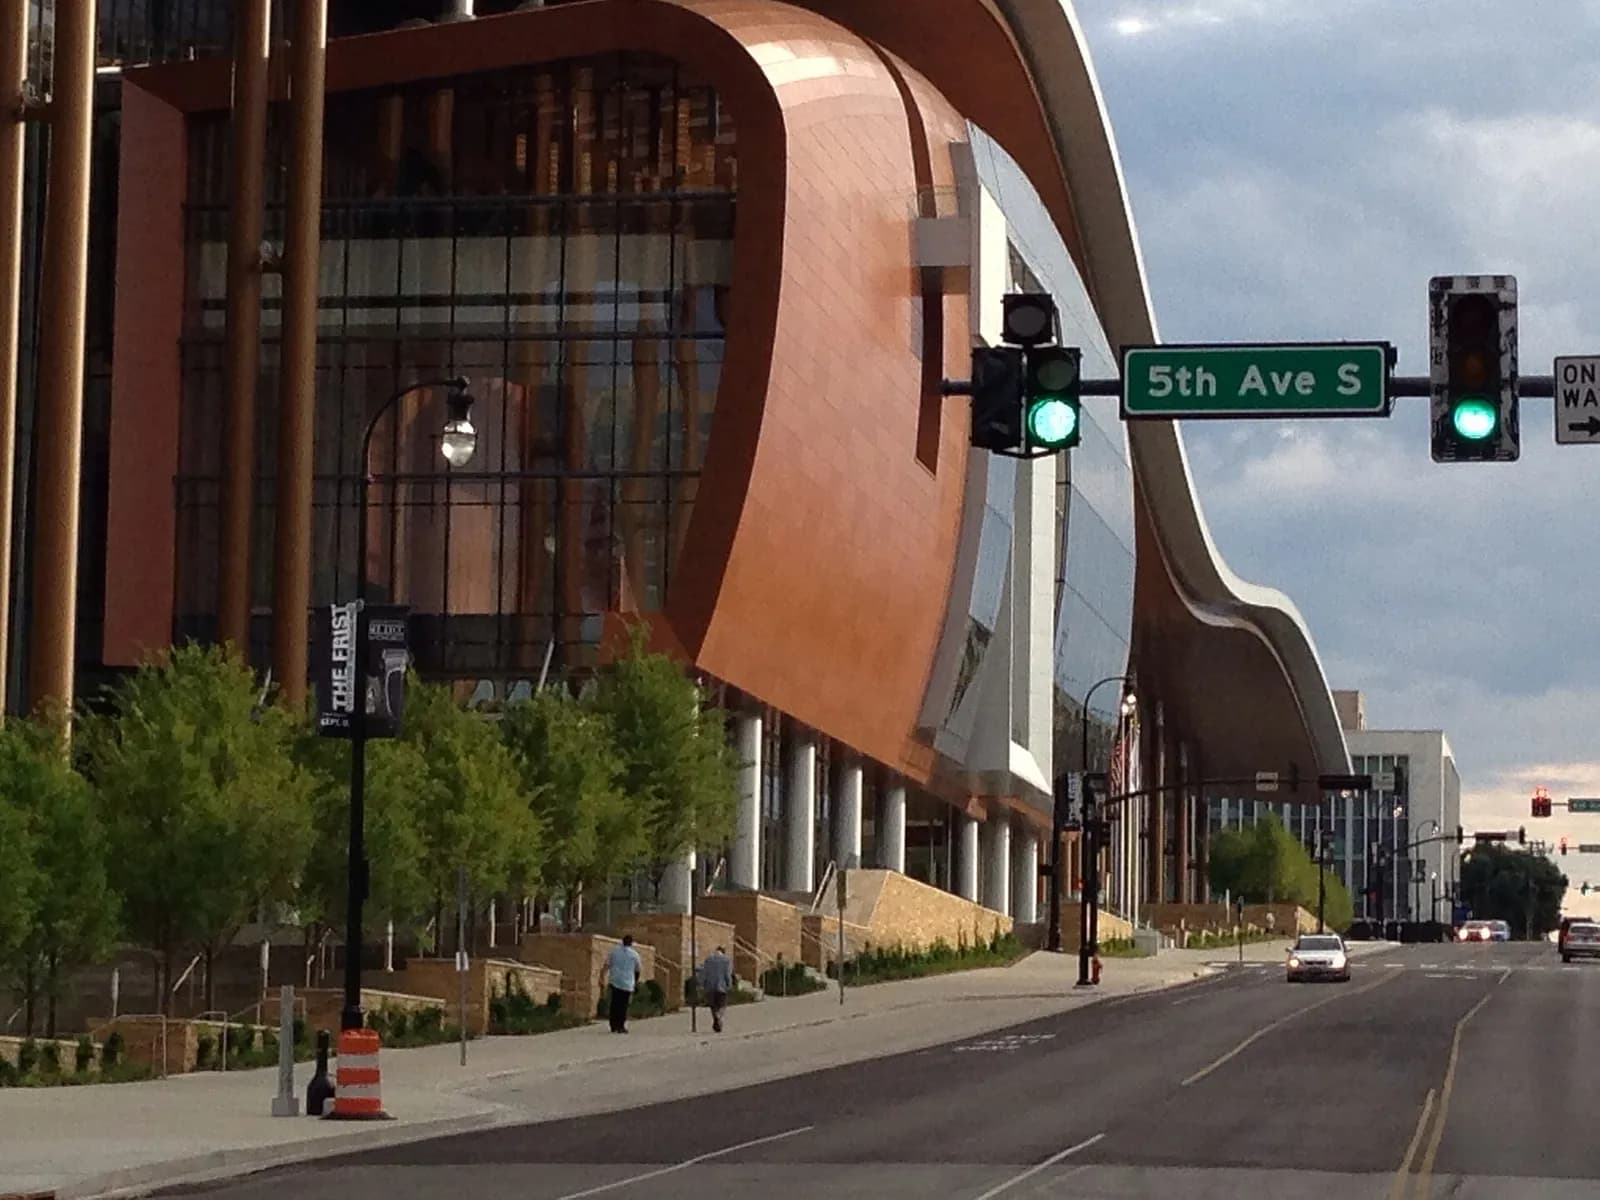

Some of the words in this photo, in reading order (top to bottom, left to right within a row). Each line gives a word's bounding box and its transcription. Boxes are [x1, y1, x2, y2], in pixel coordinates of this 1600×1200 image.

[1148, 365, 1217, 397] 5th
[1238, 365, 1316, 396] Ave
[1337, 364, 1362, 396] S
[1563, 364, 1597, 385] ON
[1563, 388, 1600, 408] WA
[331, 604, 350, 661] FRIST
[331, 668, 348, 711] THE
